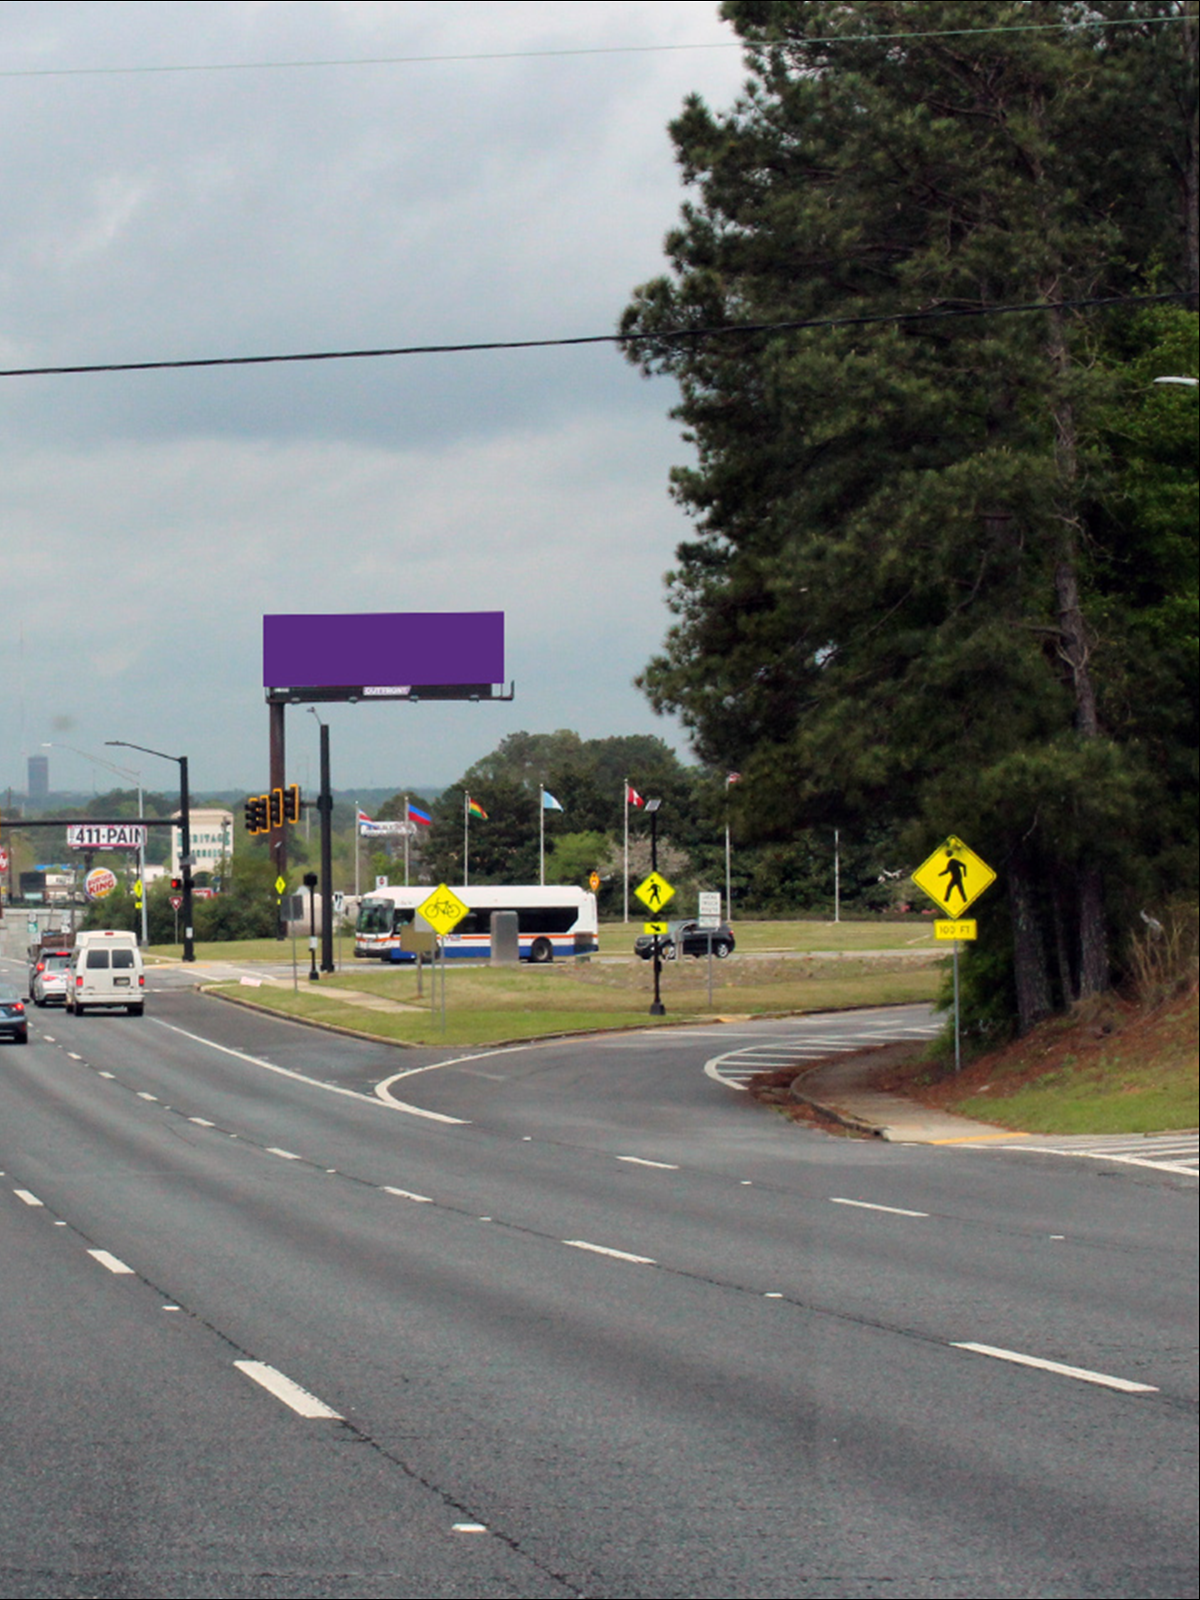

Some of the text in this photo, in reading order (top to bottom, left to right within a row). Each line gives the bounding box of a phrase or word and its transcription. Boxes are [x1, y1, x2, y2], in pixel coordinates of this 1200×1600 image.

[87, 873, 113, 887] BURGER
[88, 881, 115, 895] KING
[940, 925, 970, 934] 100 FT
